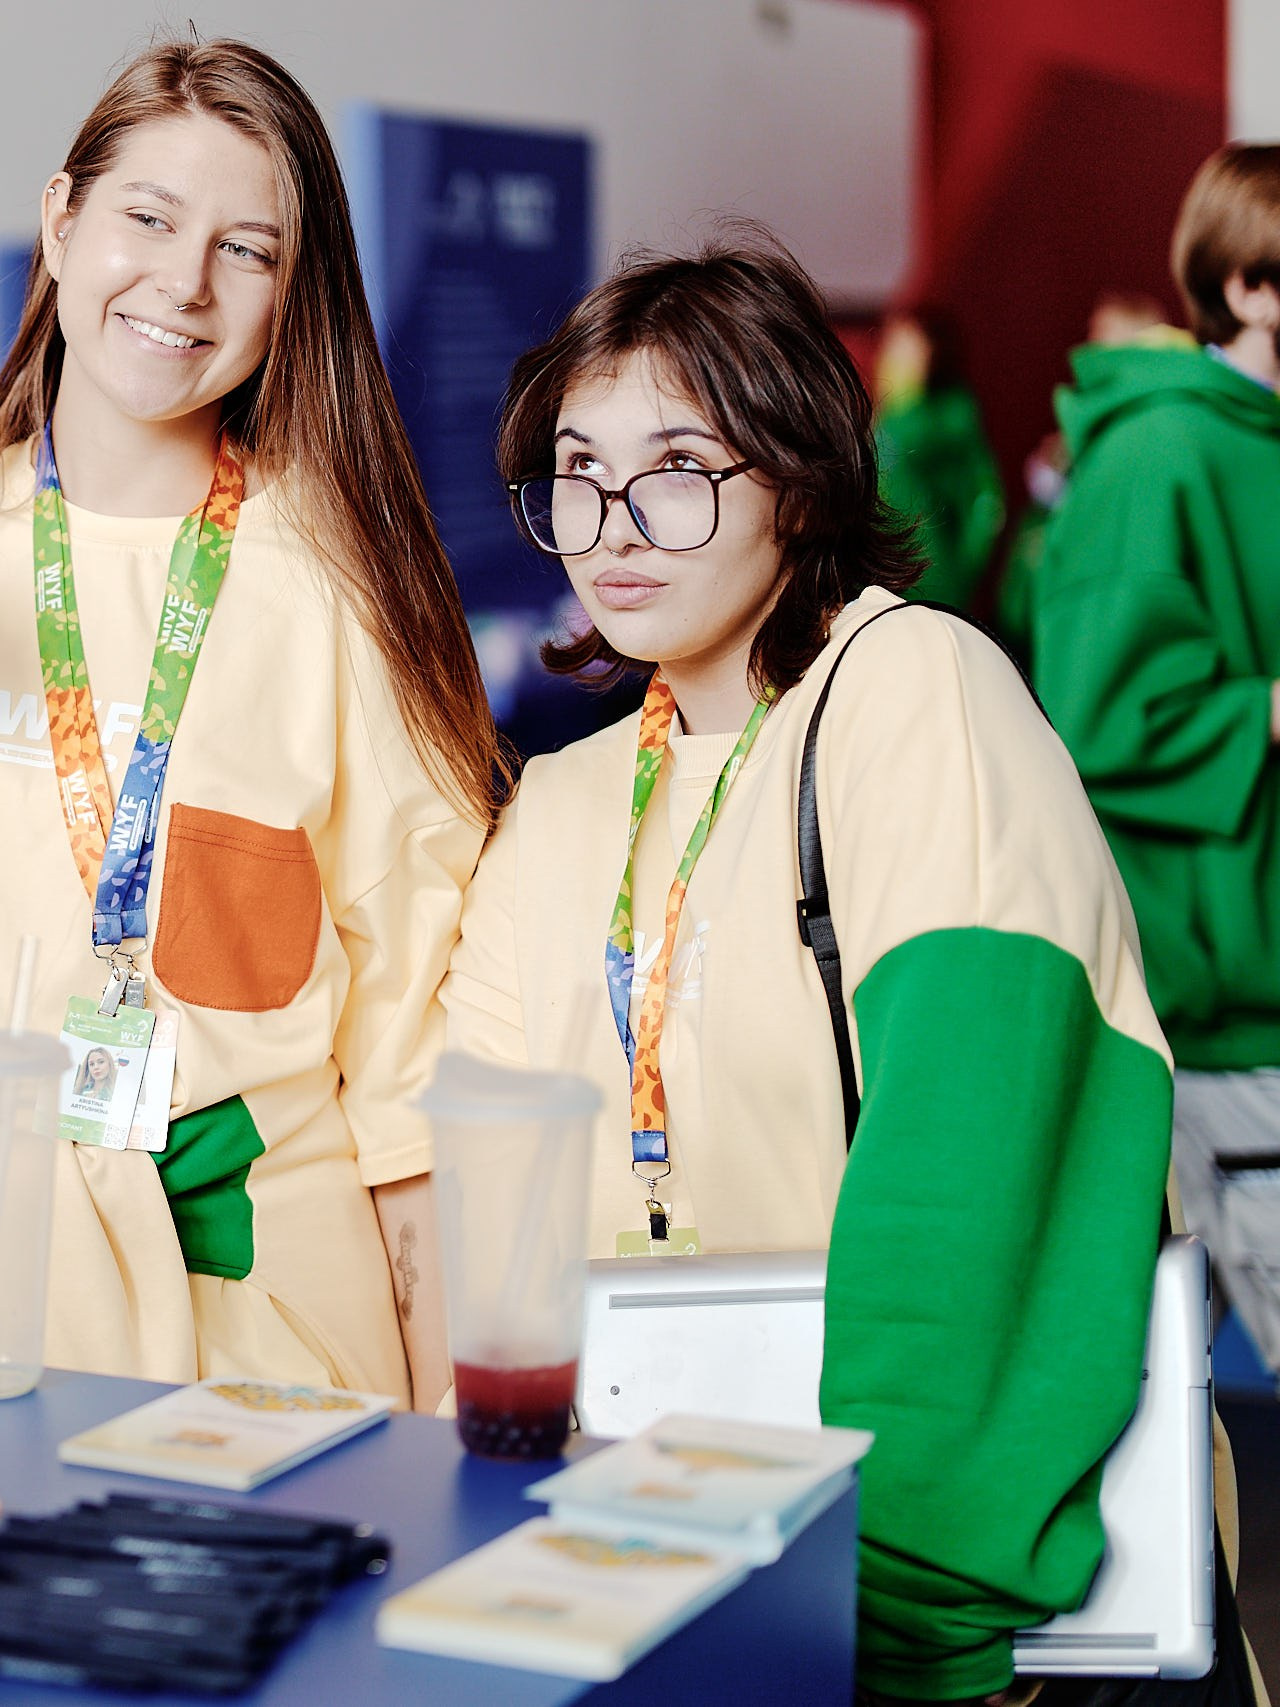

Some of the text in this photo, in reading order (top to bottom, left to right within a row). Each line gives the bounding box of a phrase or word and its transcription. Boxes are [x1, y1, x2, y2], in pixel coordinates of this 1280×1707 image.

[44, 561, 63, 610] WYF
[168, 599, 199, 653] WYF
[69, 769, 99, 827] WYF
[109, 794, 139, 851] WYF
